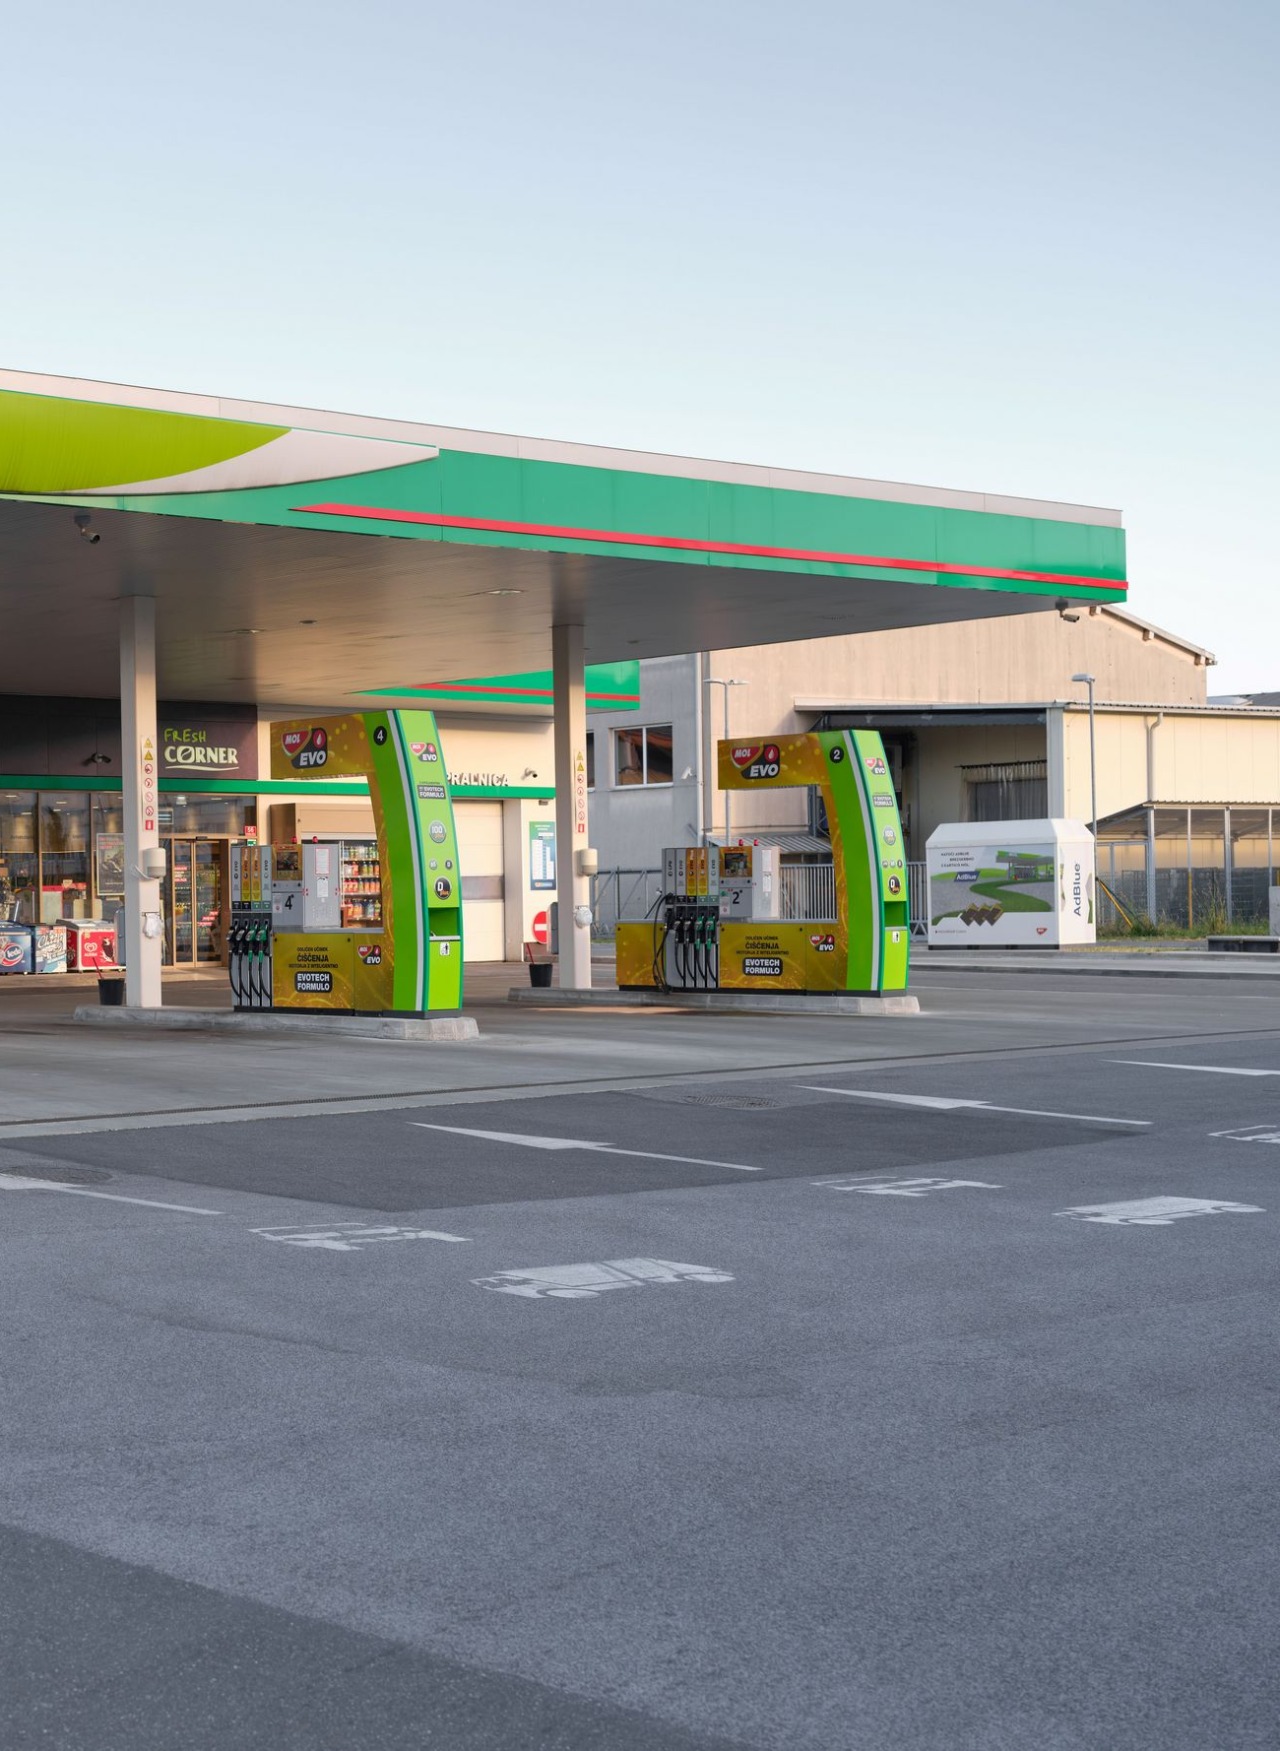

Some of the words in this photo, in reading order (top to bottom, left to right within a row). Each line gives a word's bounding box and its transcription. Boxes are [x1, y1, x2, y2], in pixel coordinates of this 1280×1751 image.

[164, 728, 206, 742] FRESH
[285, 734, 300, 744] MOL
[377, 730, 384, 742] 4
[164, 746, 238, 764] CORNER
[300, 750, 326, 766] EVO
[734, 748, 750, 758] MOL
[834, 750, 840, 760] 2
[750, 765, 778, 778] EVO
[438, 882, 444, 891] D
[285, 896, 292, 910] 4
[732, 892, 740, 904] 2
[297, 953, 329, 962] ČIŠČENJA
